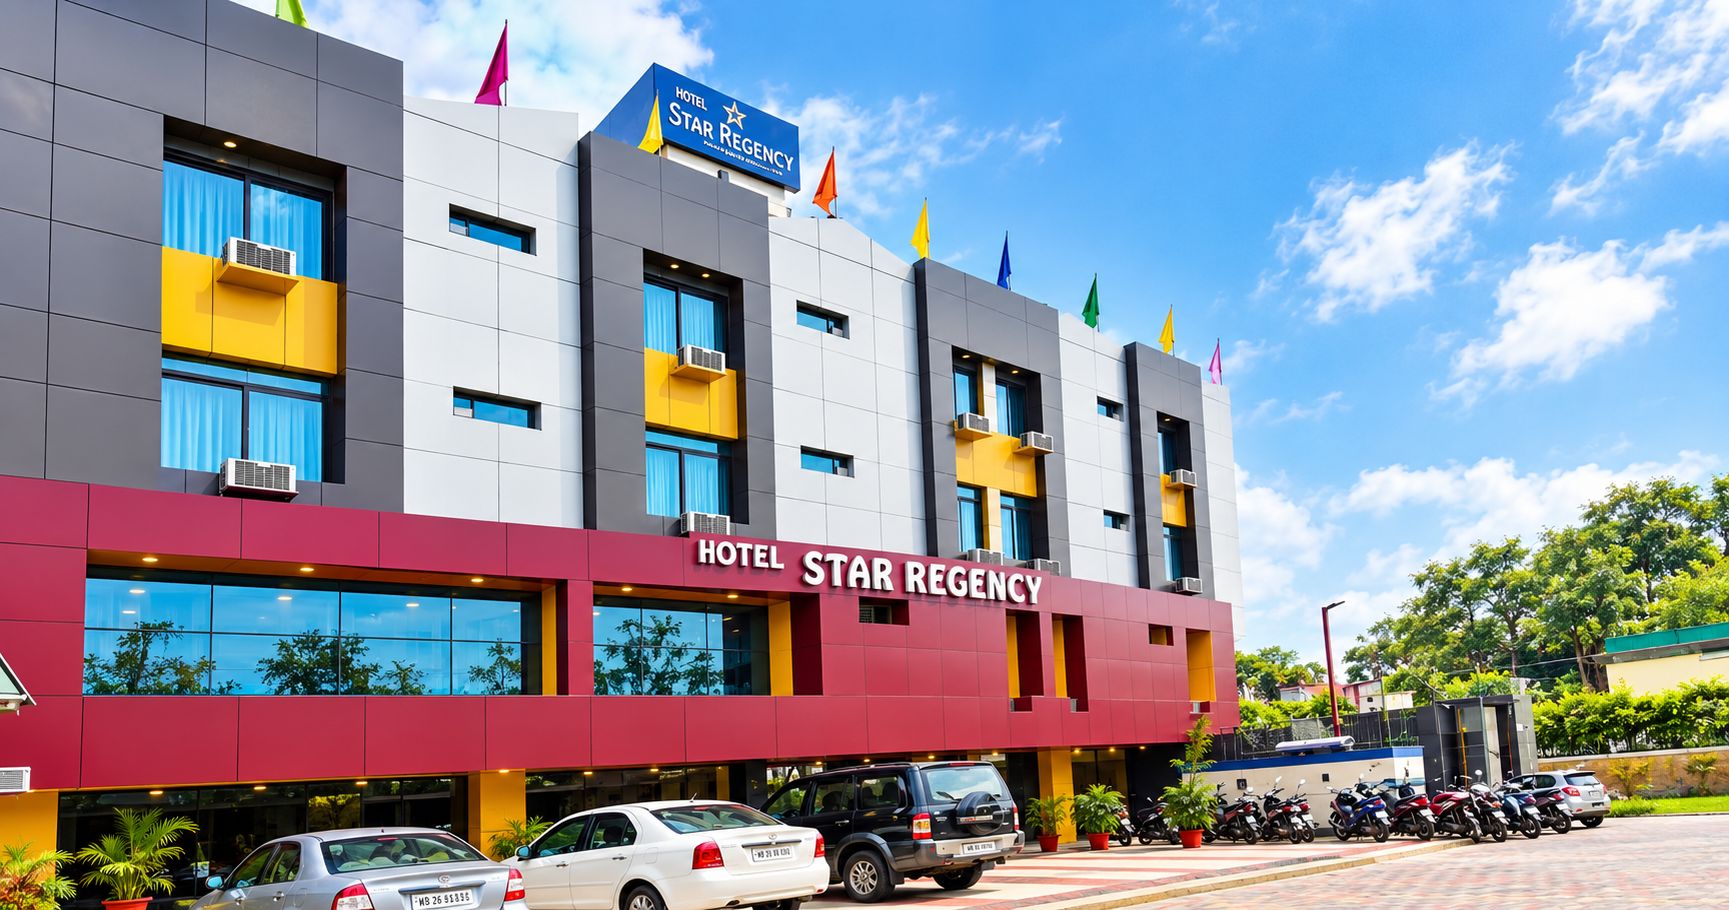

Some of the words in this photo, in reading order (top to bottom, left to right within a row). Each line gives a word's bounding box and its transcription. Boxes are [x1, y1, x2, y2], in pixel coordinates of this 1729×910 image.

[675, 86, 708, 111] HOTEL
[668, 101, 714, 140] STAR
[719, 122, 794, 172] REGENCY
[698, 539, 785, 570] HOTEL
[802, 550, 895, 592] STAR
[904, 560, 1043, 605] REGENCY
